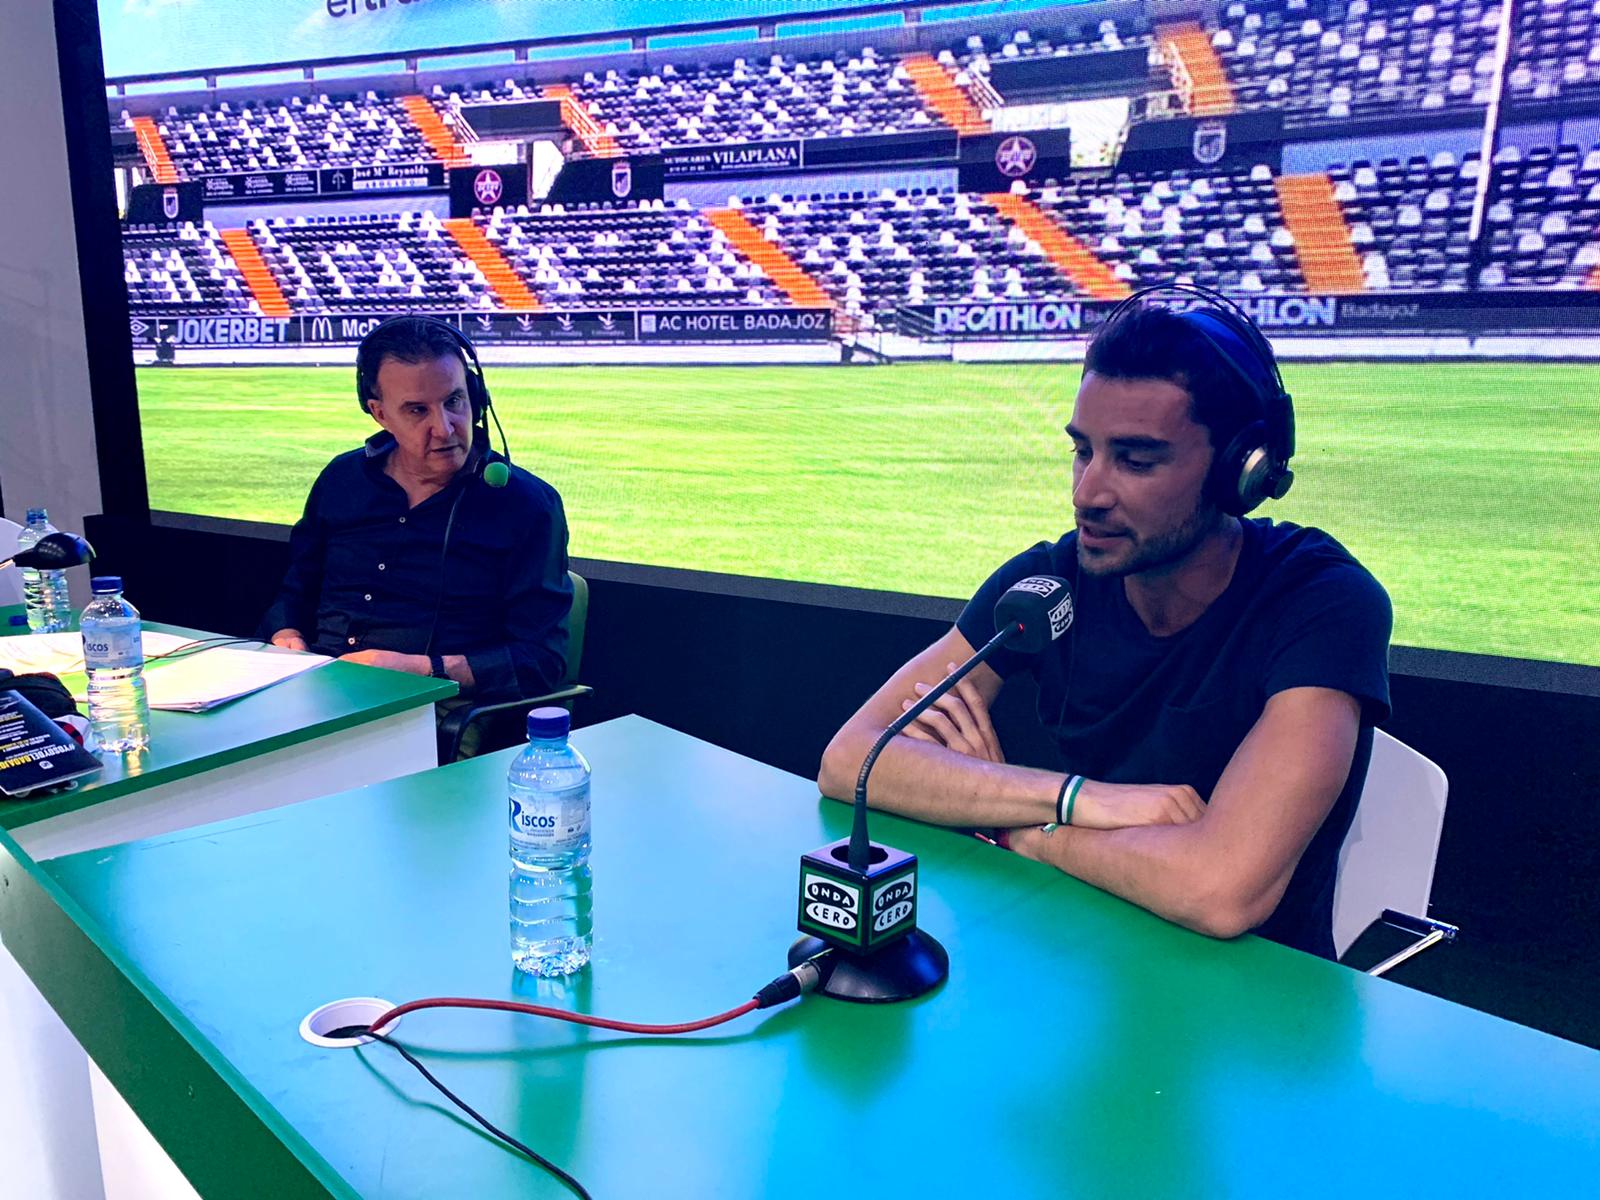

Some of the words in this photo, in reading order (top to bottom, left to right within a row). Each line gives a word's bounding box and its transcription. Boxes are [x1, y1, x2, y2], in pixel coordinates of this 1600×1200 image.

[712, 146, 797, 164] VILAPLANA
[659, 315, 681, 331] AC
[686, 314, 739, 330] HOTEL
[744, 313, 825, 330] BADAJOZ
[934, 303, 1081, 332] DECATHLON
[174, 318, 290, 343] JOKERBET
[811, 884, 851, 906] ONDA
[878, 885, 909, 907] ONDA
[813, 905, 850, 926] CERO
[879, 904, 909, 927] CERO
